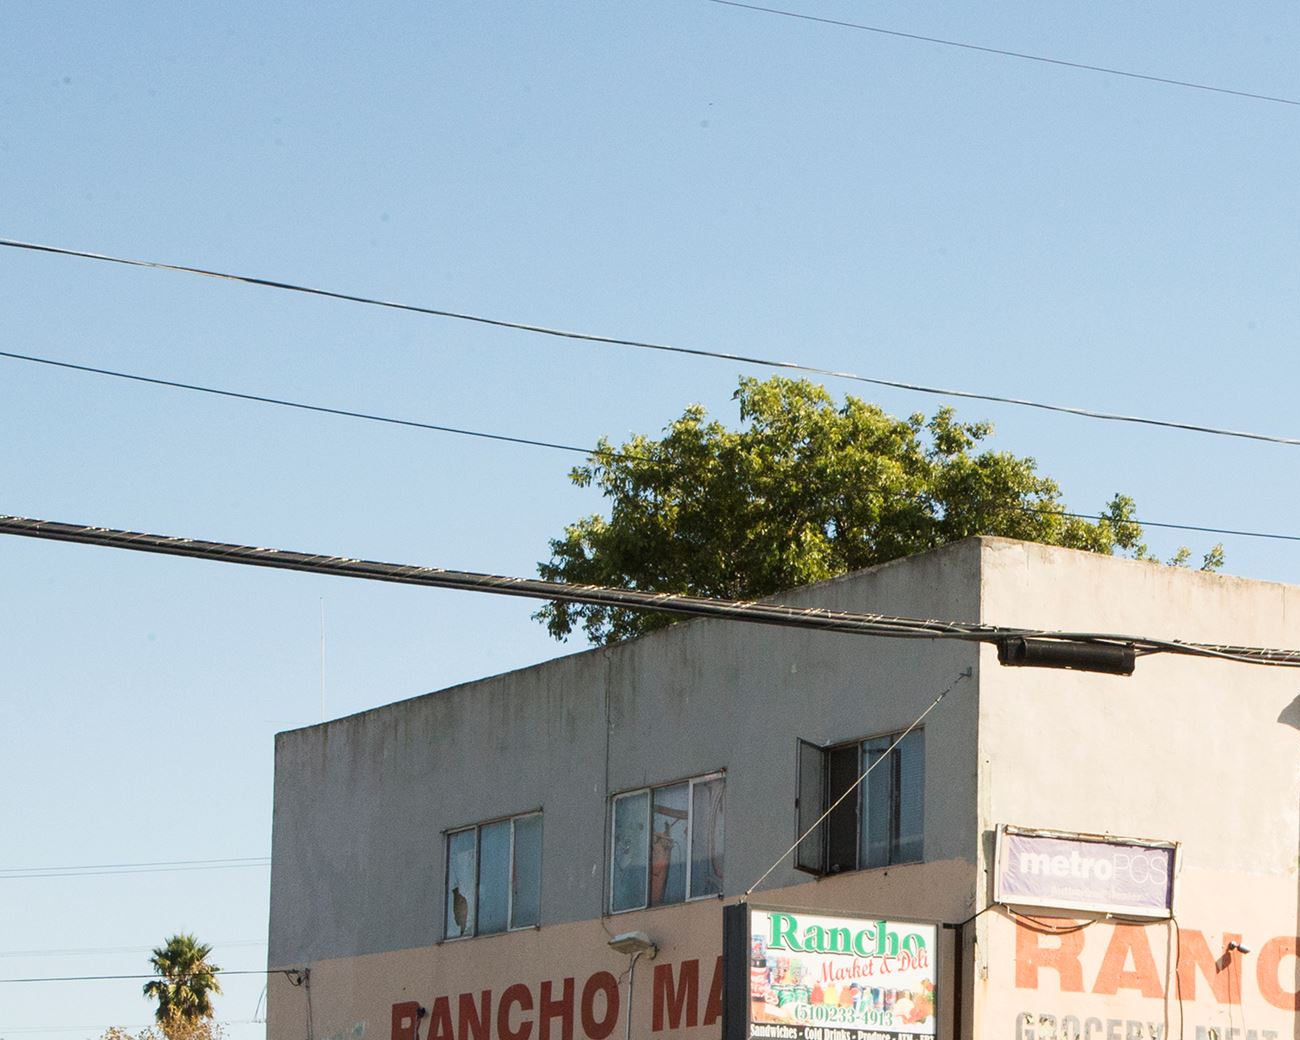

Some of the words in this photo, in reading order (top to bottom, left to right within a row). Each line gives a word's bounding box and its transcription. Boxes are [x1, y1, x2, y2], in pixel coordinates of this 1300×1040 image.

[767, 913, 927, 959] Rancho
[817, 957, 874, 984] Market
[879, 954, 892, 974] &
[897, 950, 929, 972] Deli
[794, 1004, 893, 1027] (510)233-4913
[750, 1024, 798, 1040] Sandwiches
[804, 1027, 823, 1040] Cold
